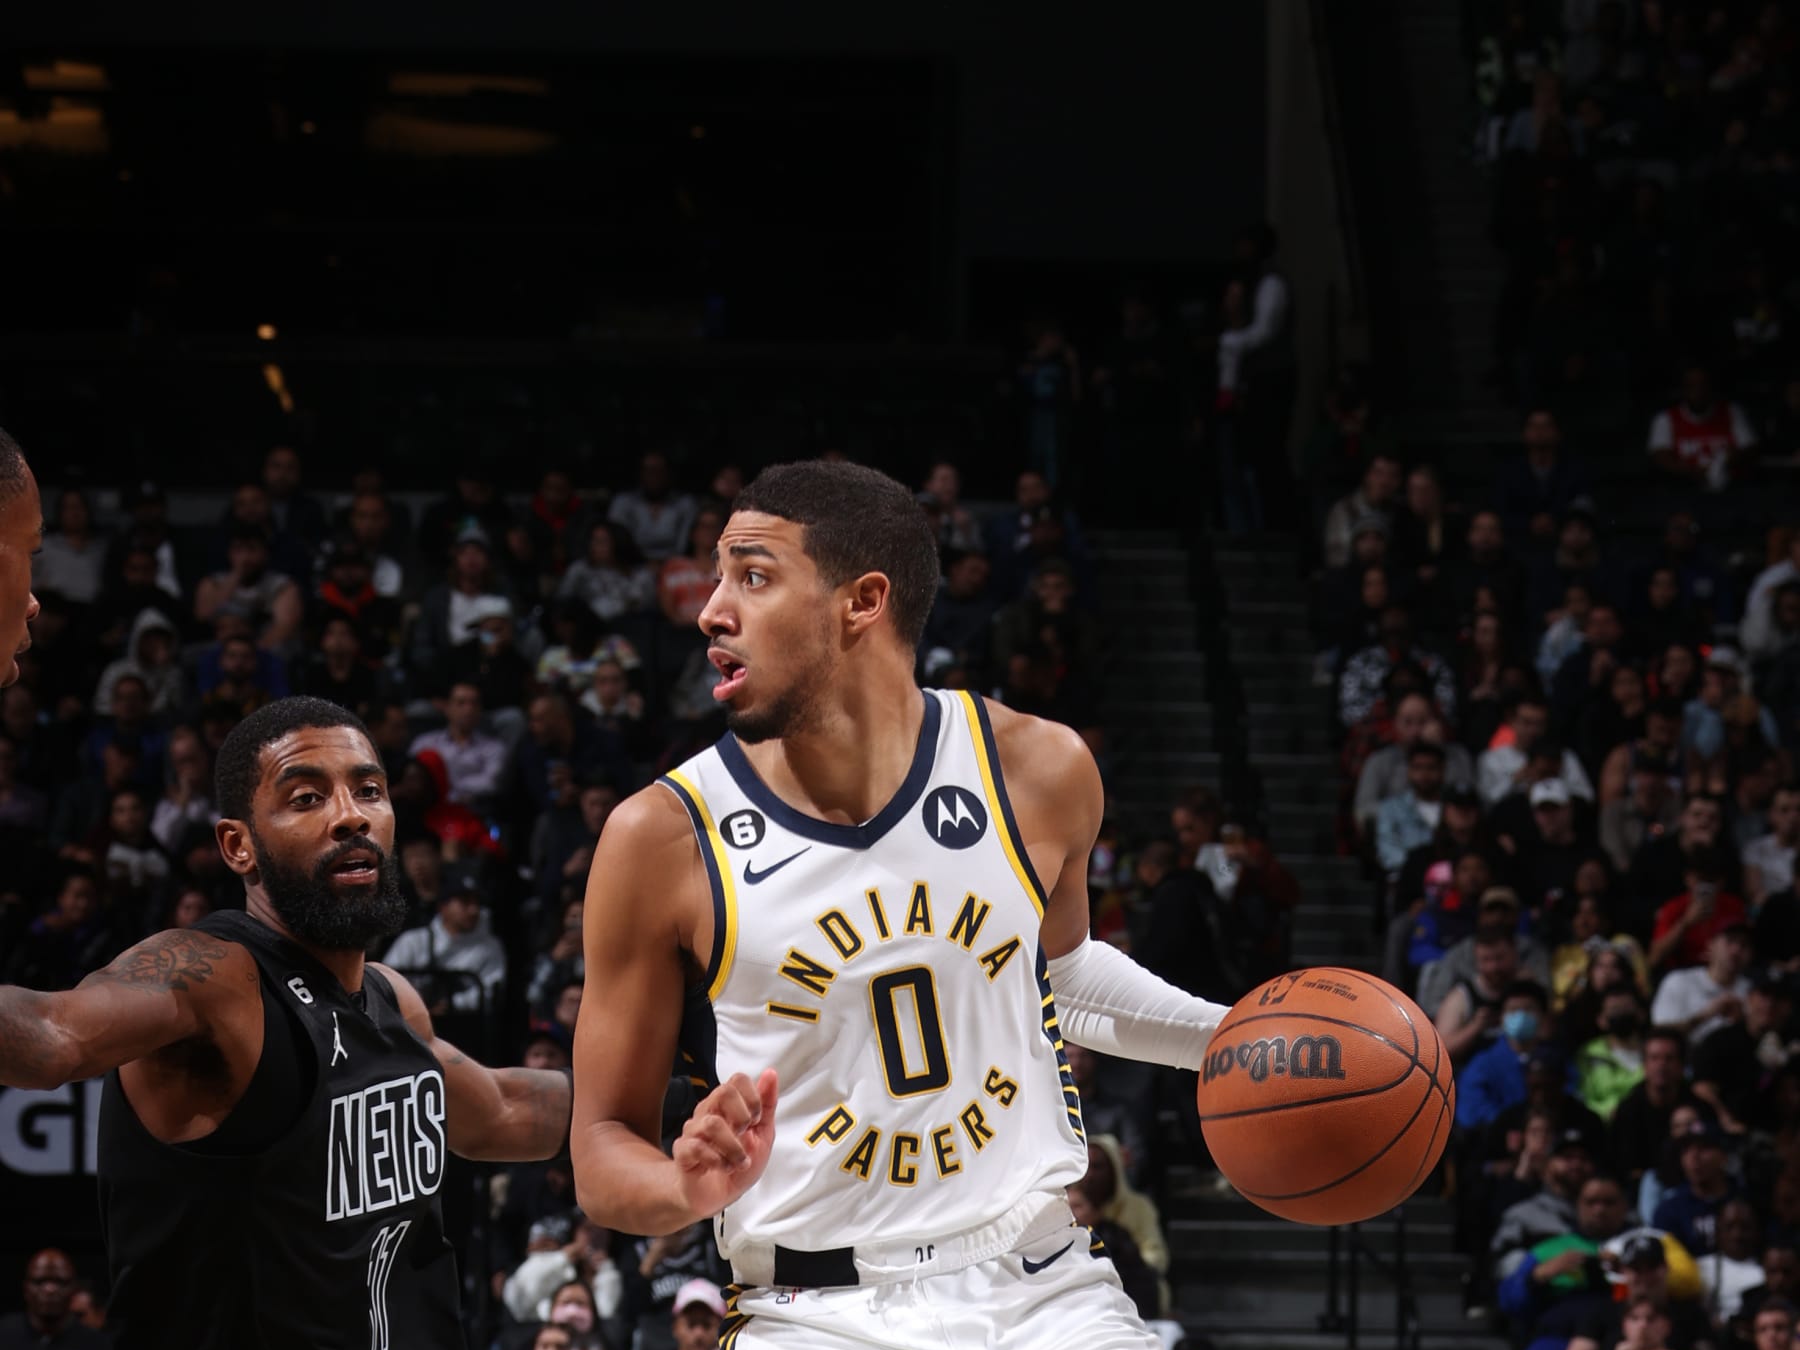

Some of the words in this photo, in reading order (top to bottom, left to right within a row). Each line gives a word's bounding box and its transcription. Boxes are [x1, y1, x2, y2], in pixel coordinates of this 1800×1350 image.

[729, 814, 757, 846] 6
[287, 976, 314, 1005] 6
[766, 880, 1022, 1024] INDIANA
[868, 963, 953, 1099] 0
[1203, 1035, 1345, 1085] Wilson
[326, 1070, 446, 1222] NETS
[804, 1065, 1020, 1187] PACERS
